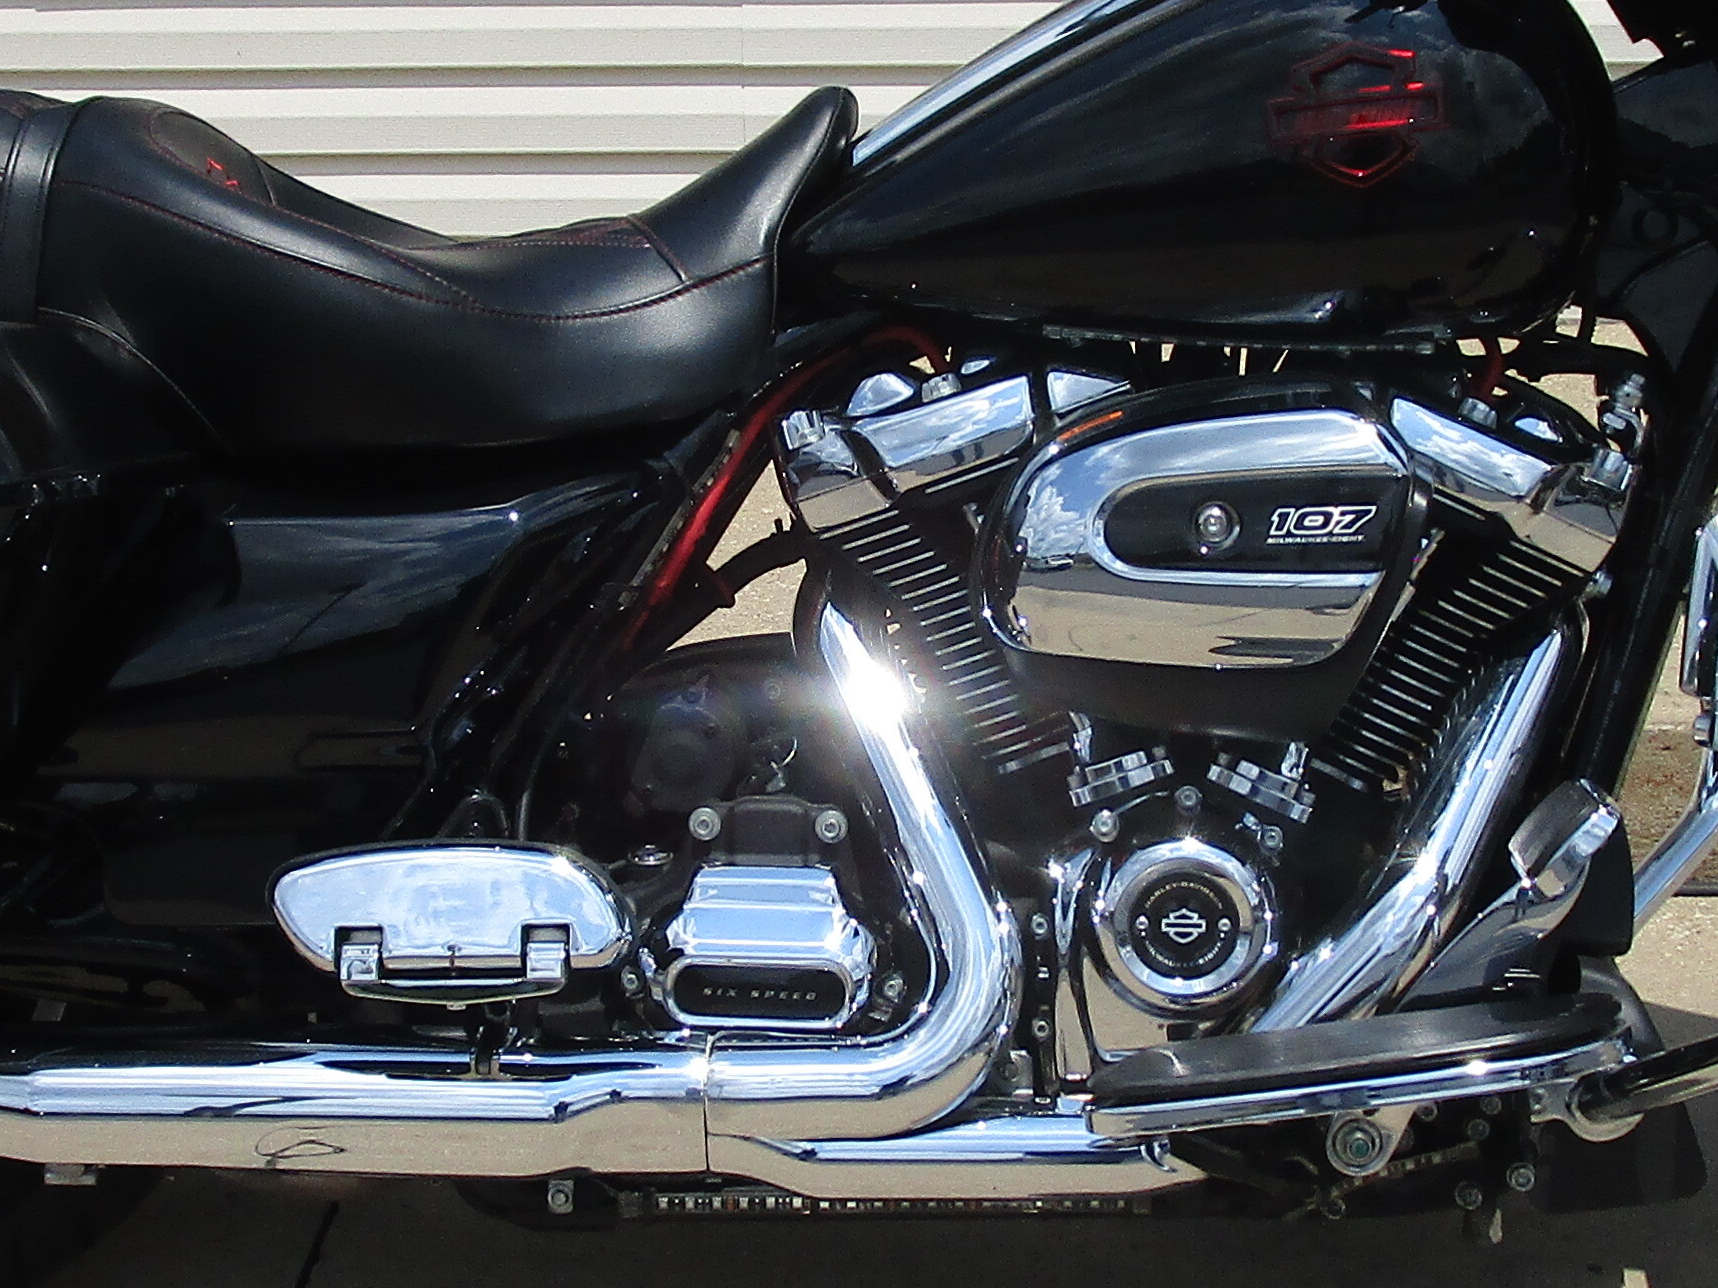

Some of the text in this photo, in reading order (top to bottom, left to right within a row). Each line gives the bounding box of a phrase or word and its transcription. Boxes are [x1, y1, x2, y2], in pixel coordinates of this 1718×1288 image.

[1269, 505, 1378, 535] 107
[703, 987, 816, 1001] SIX SPEED
